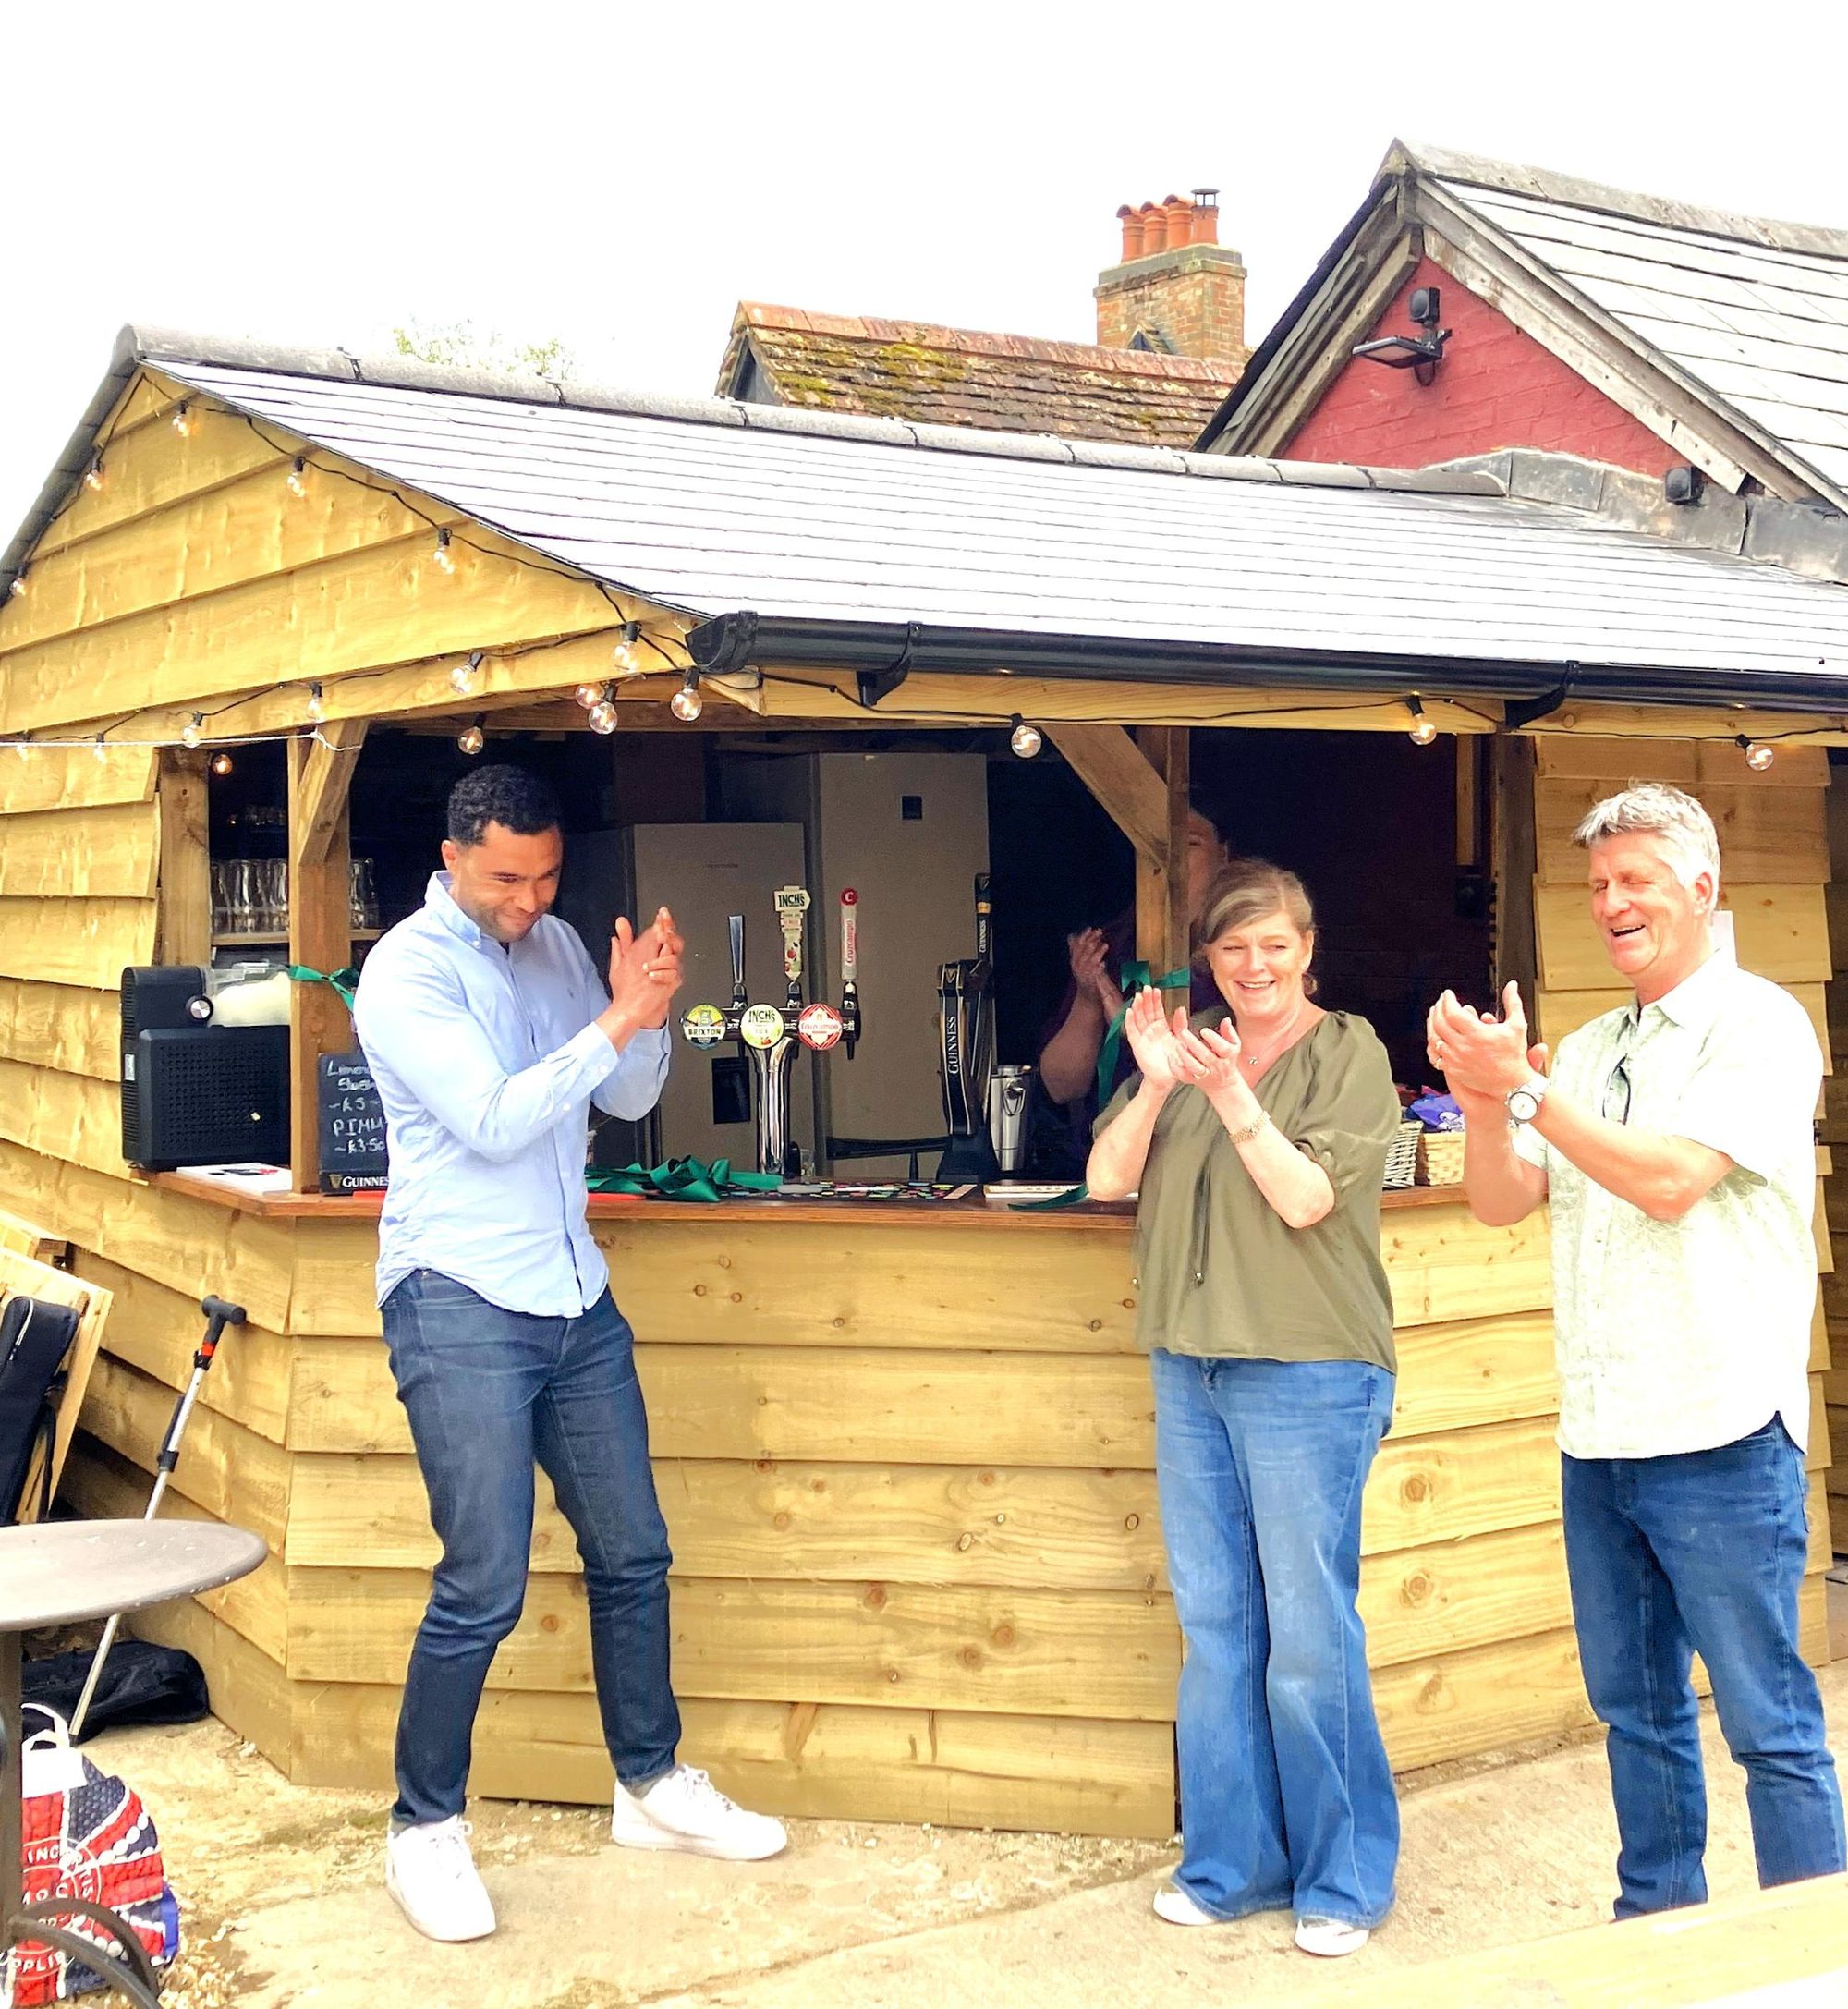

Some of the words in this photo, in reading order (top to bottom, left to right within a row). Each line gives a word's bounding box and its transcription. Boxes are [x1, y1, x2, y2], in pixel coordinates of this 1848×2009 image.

[778, 893, 806, 907] INCH'S
[979, 919, 987, 953] GUINNESS
[748, 1009, 775, 1023] INCH'S
[947, 1016, 959, 1075] GUINNESS
